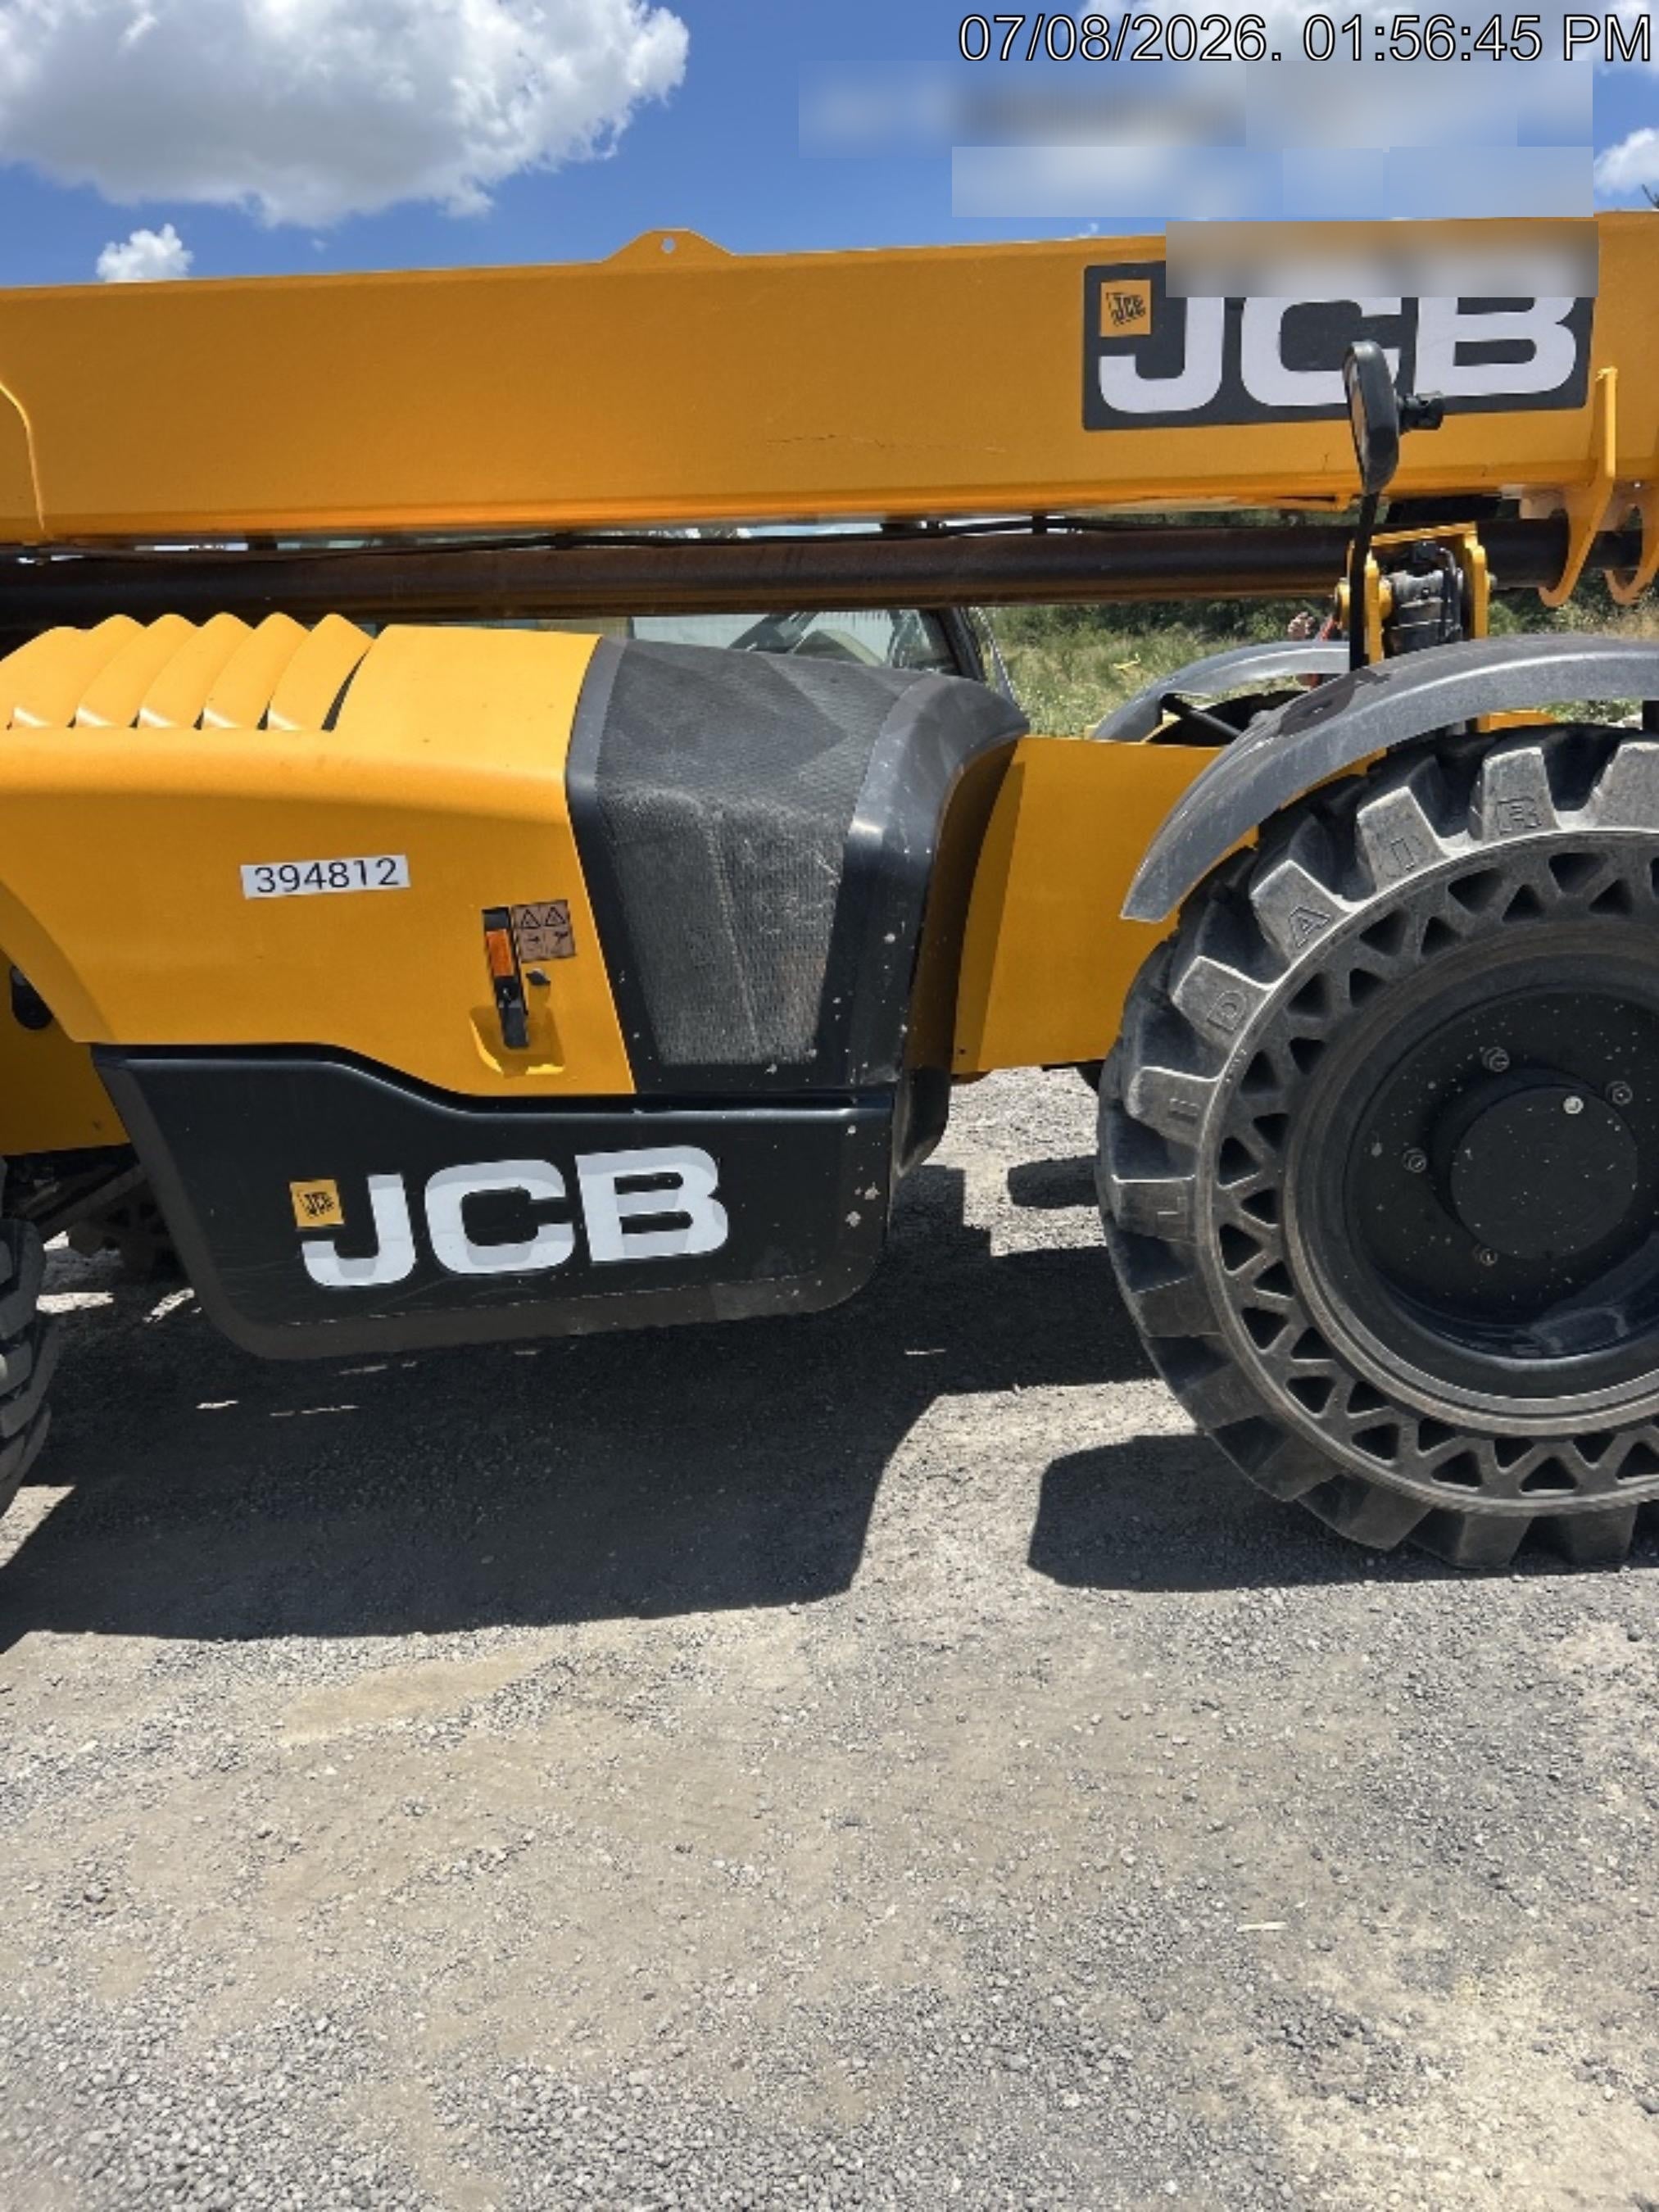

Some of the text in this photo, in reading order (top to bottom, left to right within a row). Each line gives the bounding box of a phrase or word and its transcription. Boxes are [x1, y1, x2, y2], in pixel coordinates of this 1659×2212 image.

[1098, 297, 1577, 414] JCB
[254, 858, 400, 893] 394812
[301, 1145, 729, 1289] JCB
